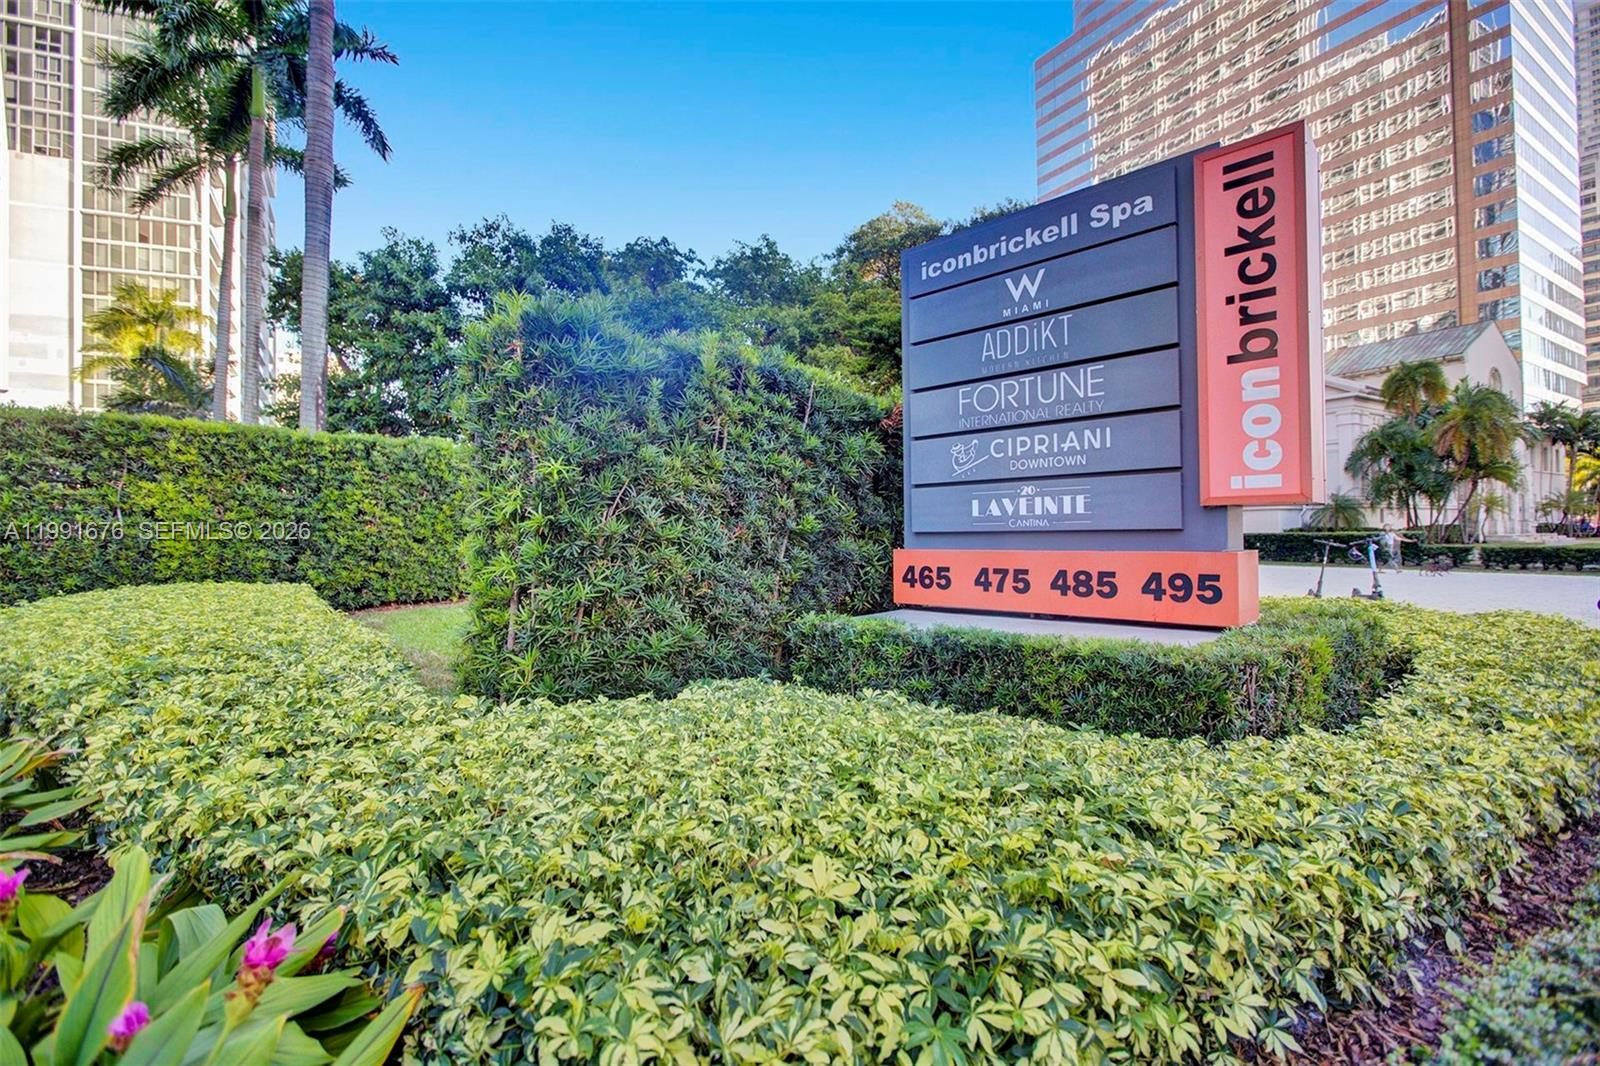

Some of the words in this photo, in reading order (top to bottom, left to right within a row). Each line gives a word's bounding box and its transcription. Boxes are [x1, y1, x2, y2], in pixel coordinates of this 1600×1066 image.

[921, 213, 1078, 280] iconbrickell
[1090, 195, 1153, 228] Spa
[1005, 268, 1045, 302] W
[1003, 299, 1049, 317] MIAMI
[959, 364, 1105, 415] FORTUNE
[959, 408, 1051, 428] INTERNATIONAL
[1055, 399, 1105, 417] REALTY
[990, 426, 1112, 458] CIPRIANI
[1010, 454, 1087, 471] DOWNTOWN
[1008, 518, 1050, 529] CANTINA
[902, 565, 952, 590] 465
[974, 567, 1032, 594] 475
[1050, 569, 1118, 599] 485
[1141, 572, 1224, 605] 495
